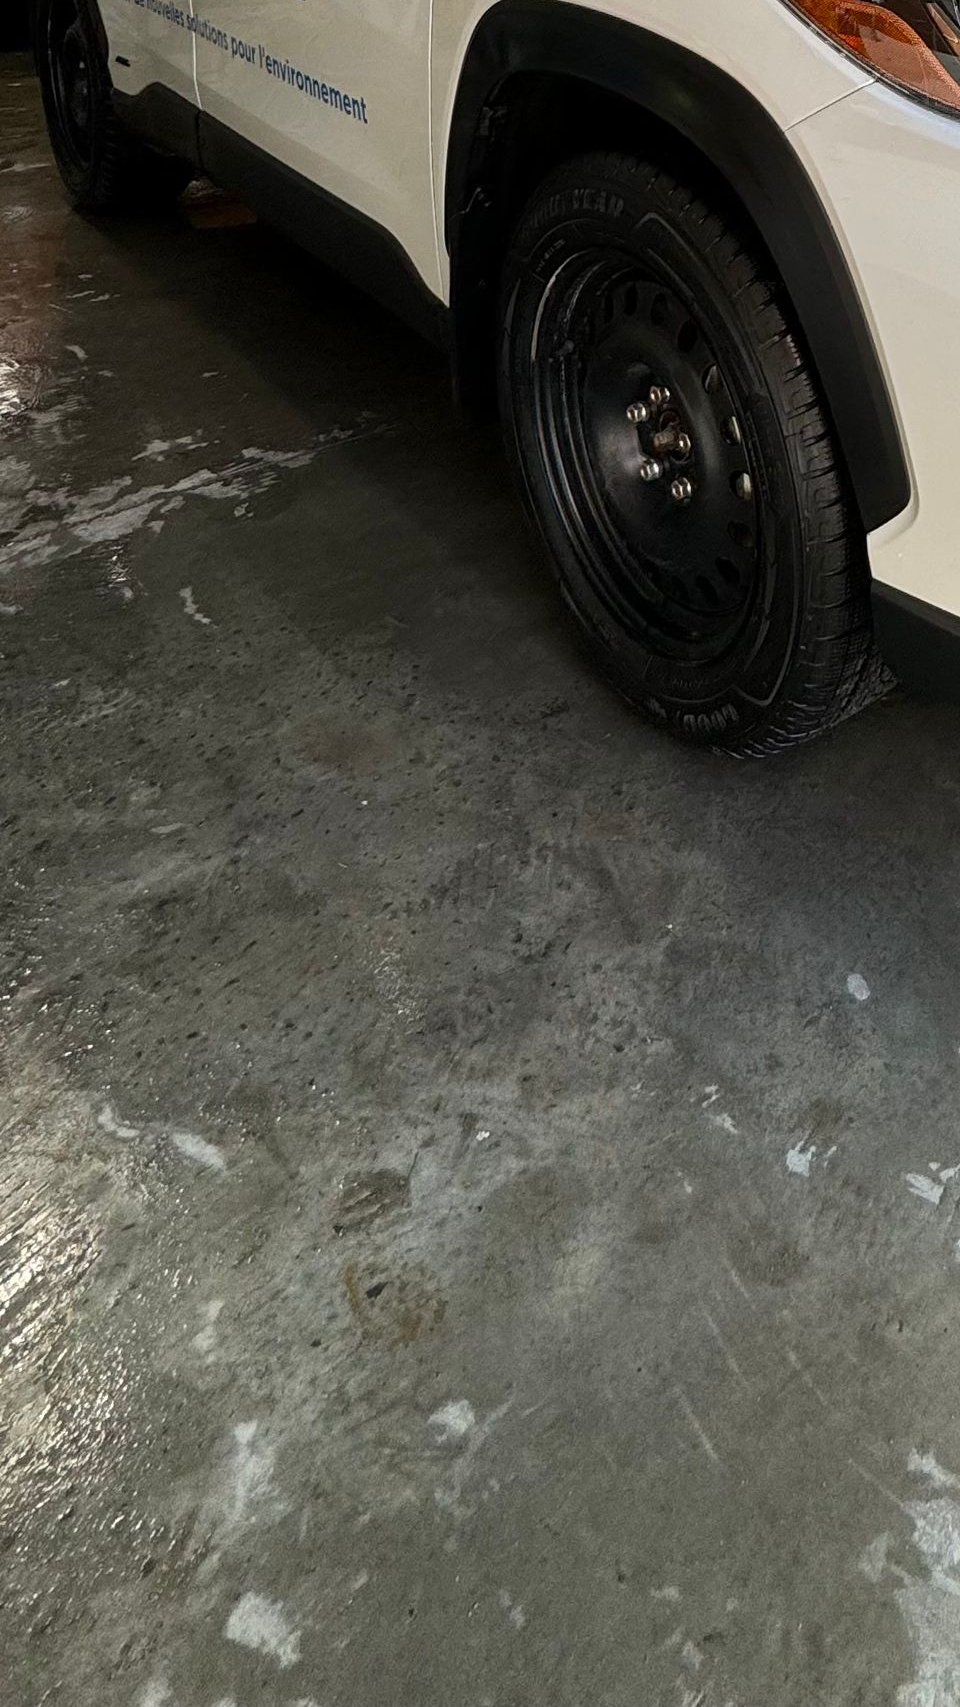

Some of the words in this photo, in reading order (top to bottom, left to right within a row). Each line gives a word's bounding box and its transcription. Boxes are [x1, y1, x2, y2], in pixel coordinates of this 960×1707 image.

[186, 13, 228, 50] solutions
[230, 36, 256, 64] pour
[258, 43, 369, 125] l'environnement
